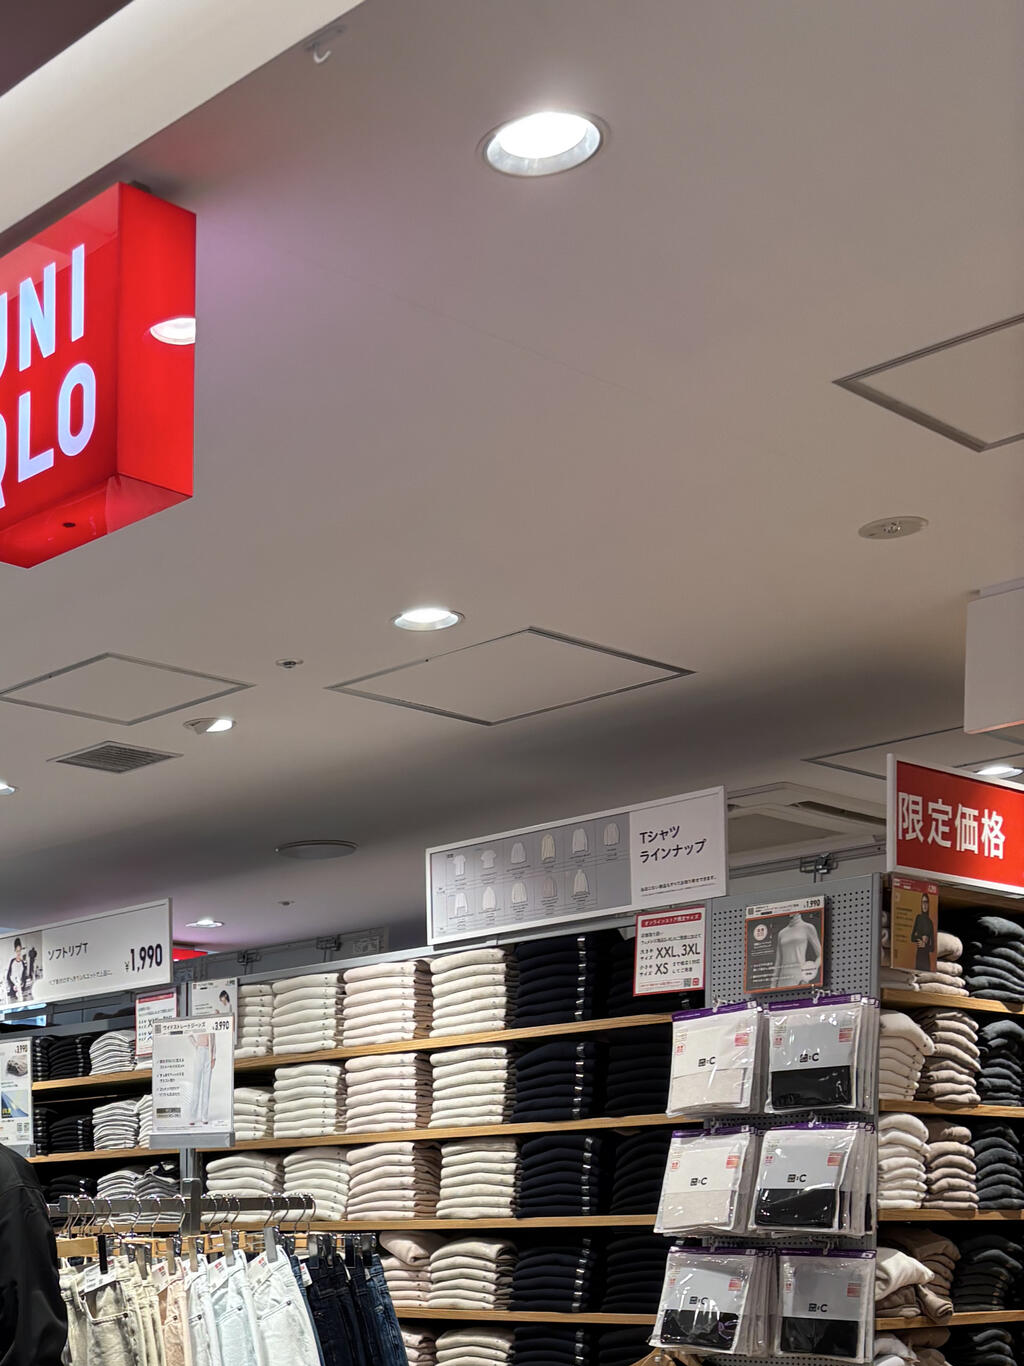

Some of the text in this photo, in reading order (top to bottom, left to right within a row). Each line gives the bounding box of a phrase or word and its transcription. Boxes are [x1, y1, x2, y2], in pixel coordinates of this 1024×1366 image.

[639, 825, 680, 844] Tシャツ
[897, 791, 1006, 860] 限定価格
[639, 838, 707, 864] ラインナップ
[48, 942, 89, 960] ソフトリブT
[655, 962, 669, 975] XS
